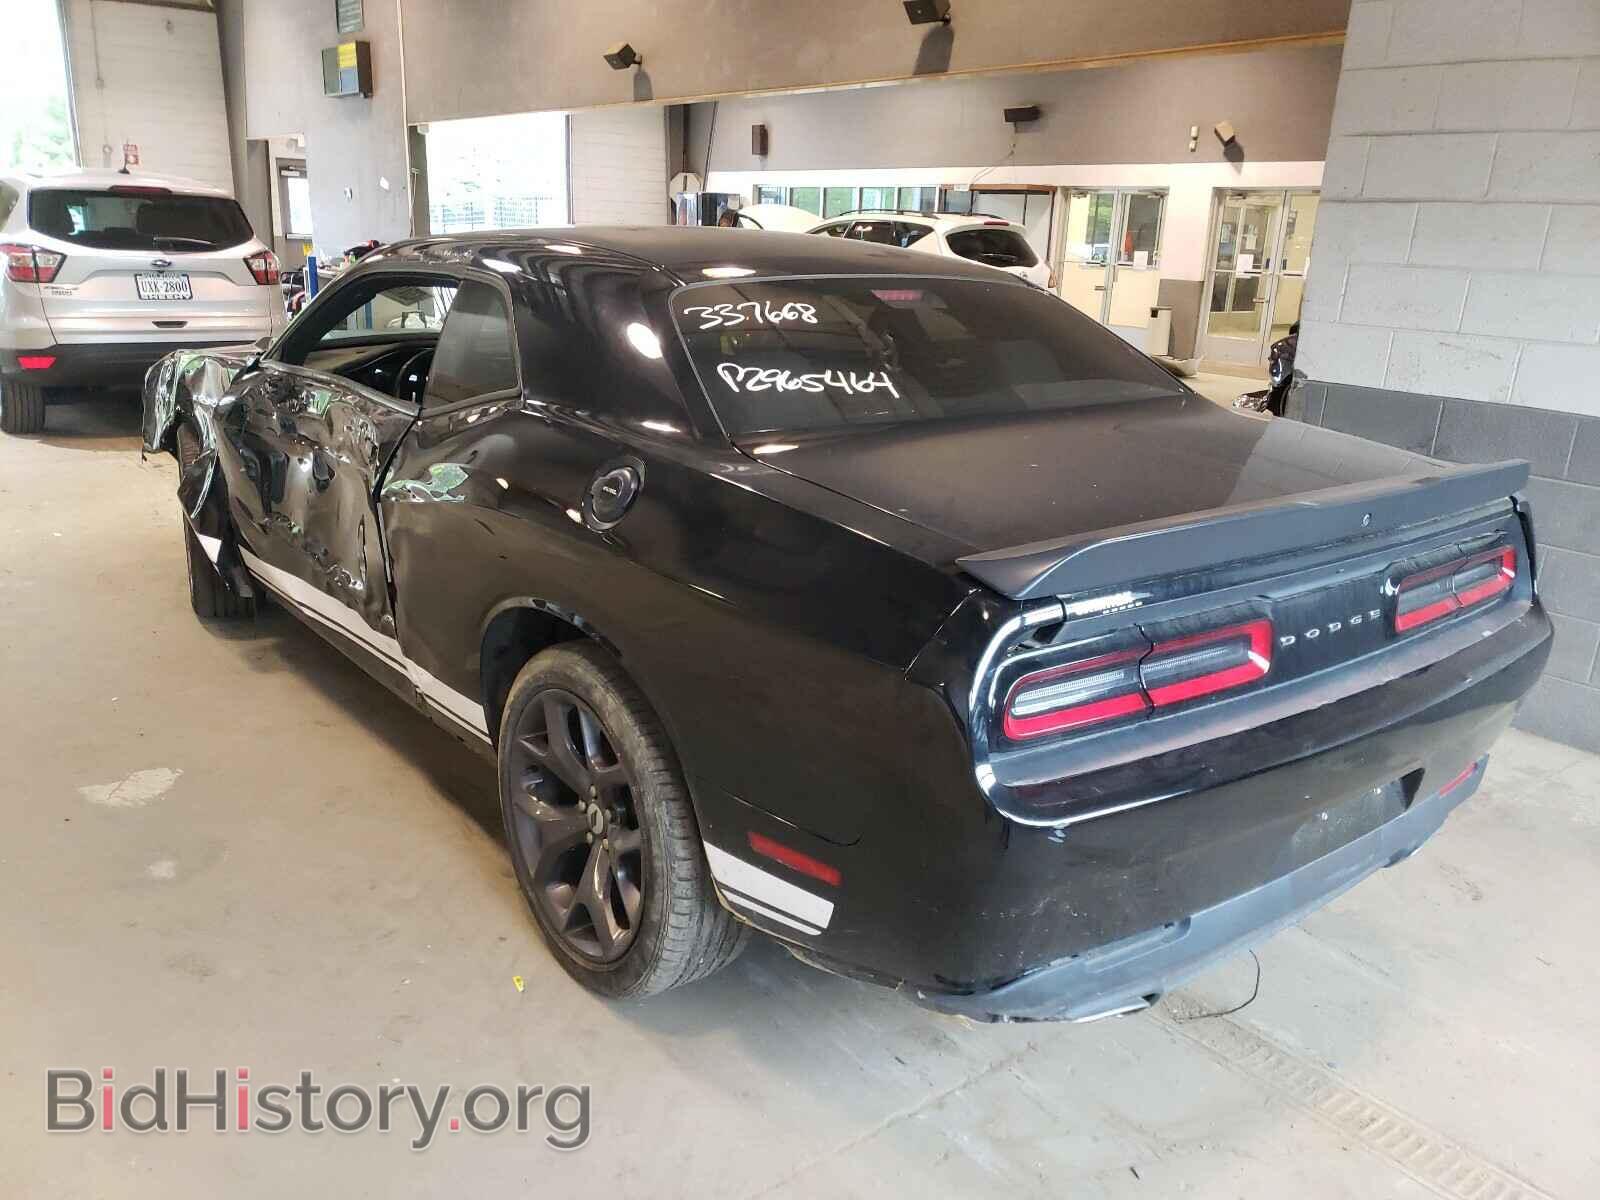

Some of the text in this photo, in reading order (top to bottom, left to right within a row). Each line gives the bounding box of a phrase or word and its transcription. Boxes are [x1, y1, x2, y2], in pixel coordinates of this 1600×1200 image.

[684, 301, 818, 330] 337668
[716, 362, 899, 399] P2965464
[1279, 608, 1381, 647] DODGE
